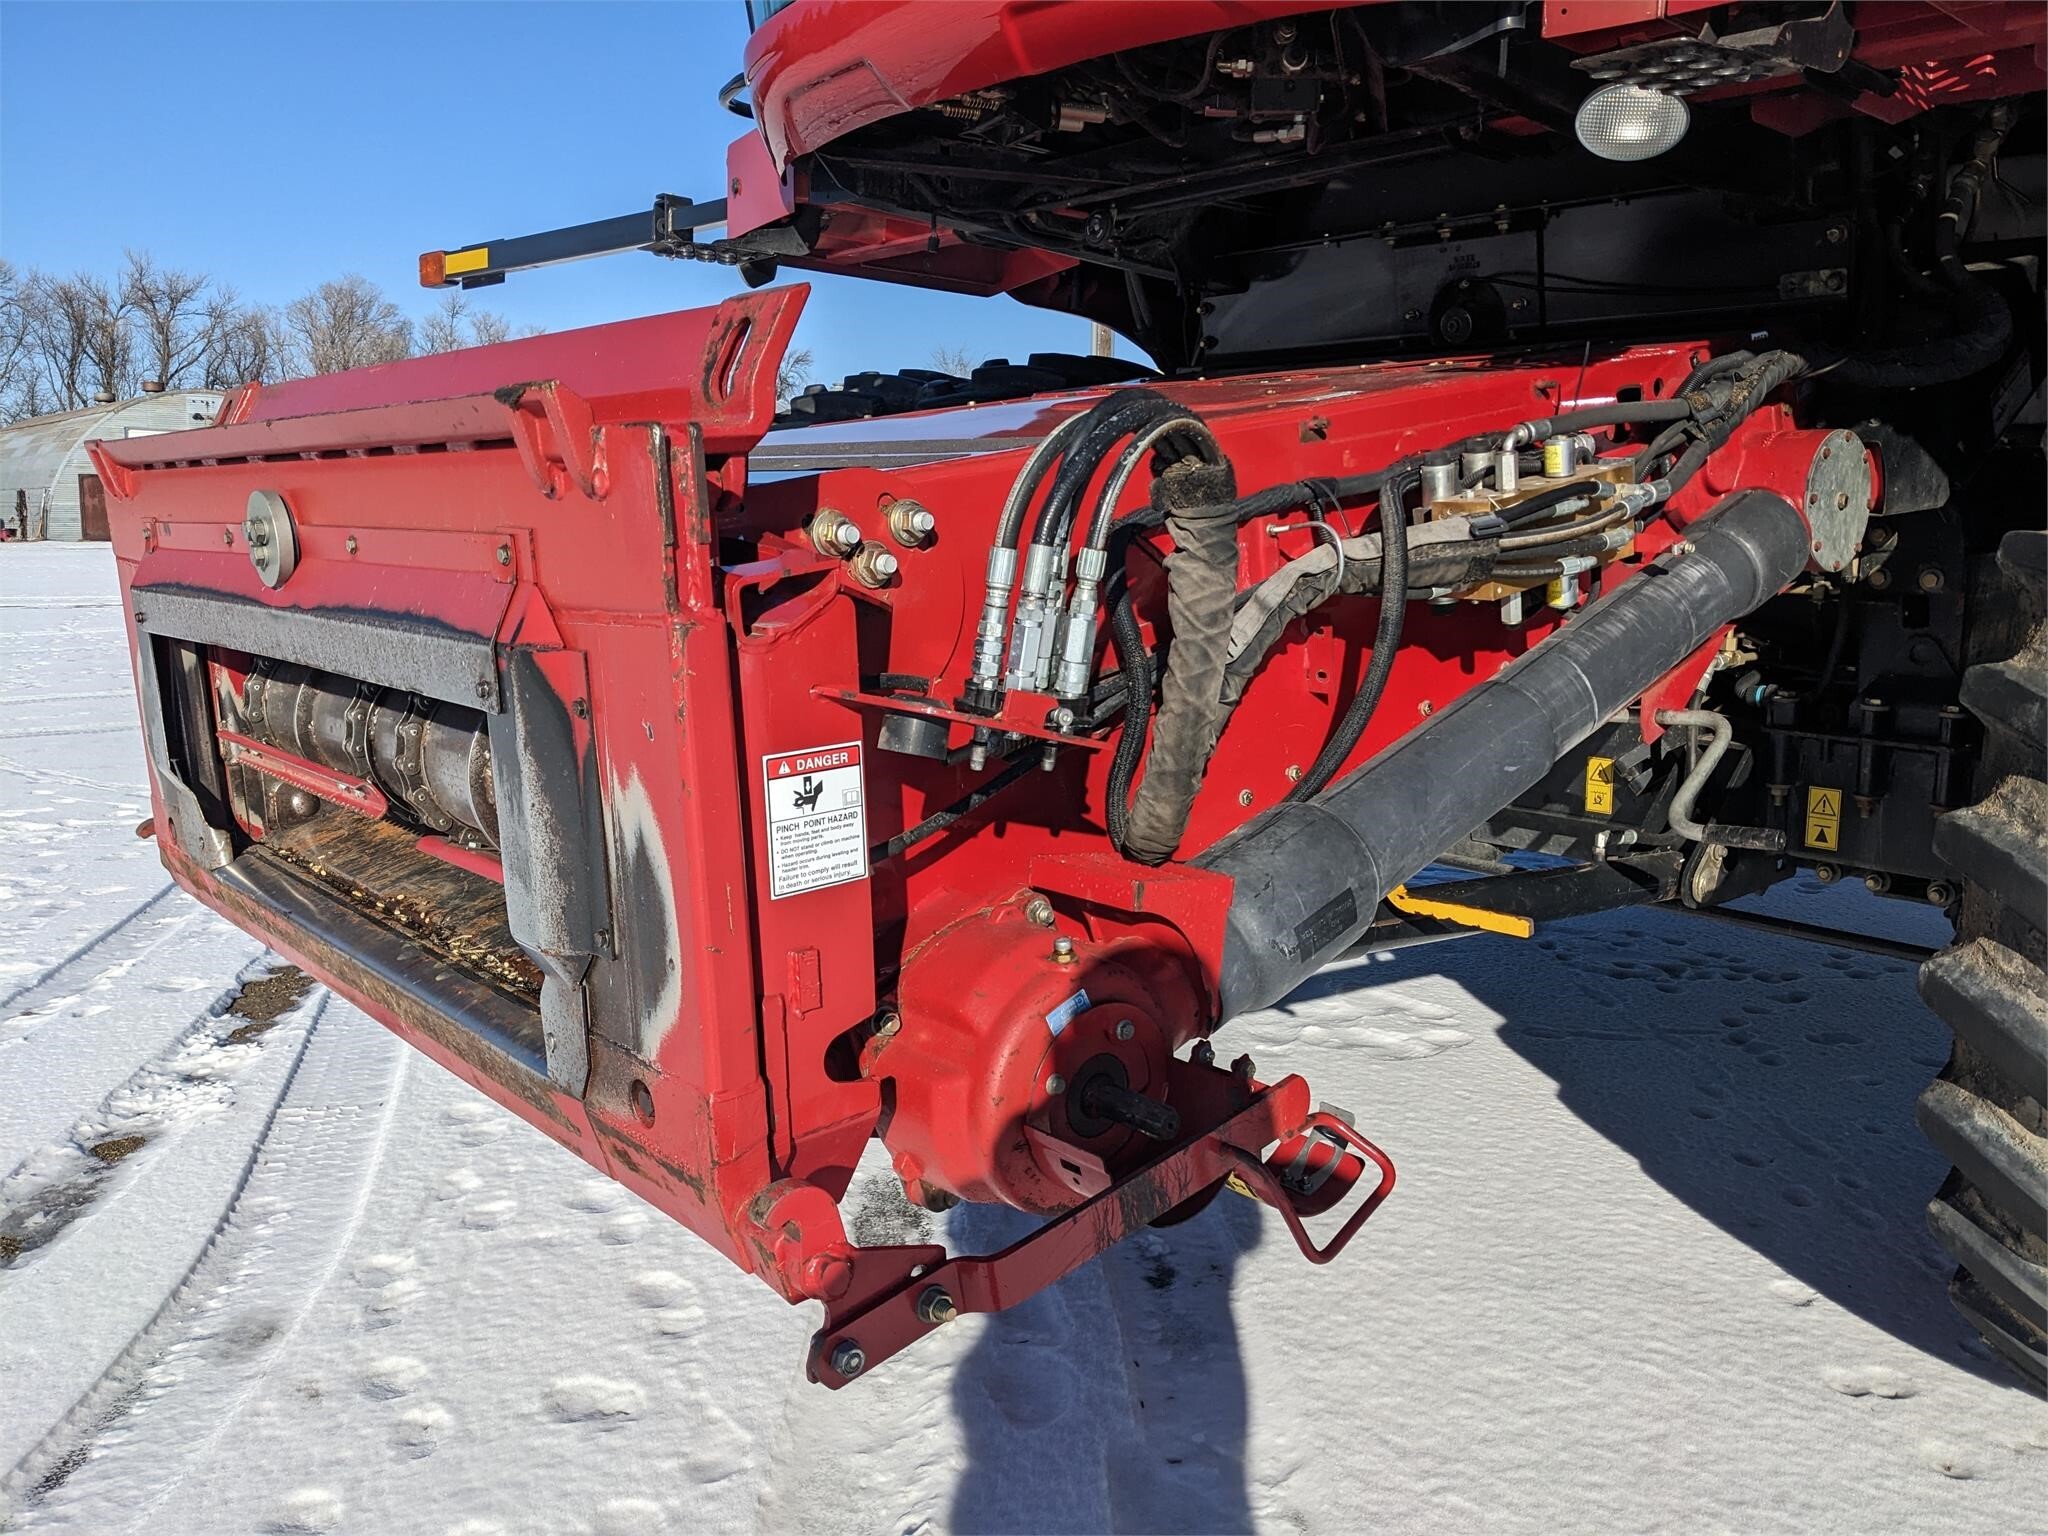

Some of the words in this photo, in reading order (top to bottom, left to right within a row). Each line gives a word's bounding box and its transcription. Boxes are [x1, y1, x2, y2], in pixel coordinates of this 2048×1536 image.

[796, 752, 849, 771] DANGER
[776, 823, 799, 834] PINCH
[804, 817, 825, 828] POINT
[828, 811, 858, 823] HAZARD
[779, 874, 799, 882] Failure
[808, 867, 829, 876] comply
[786, 881, 802, 889] death
